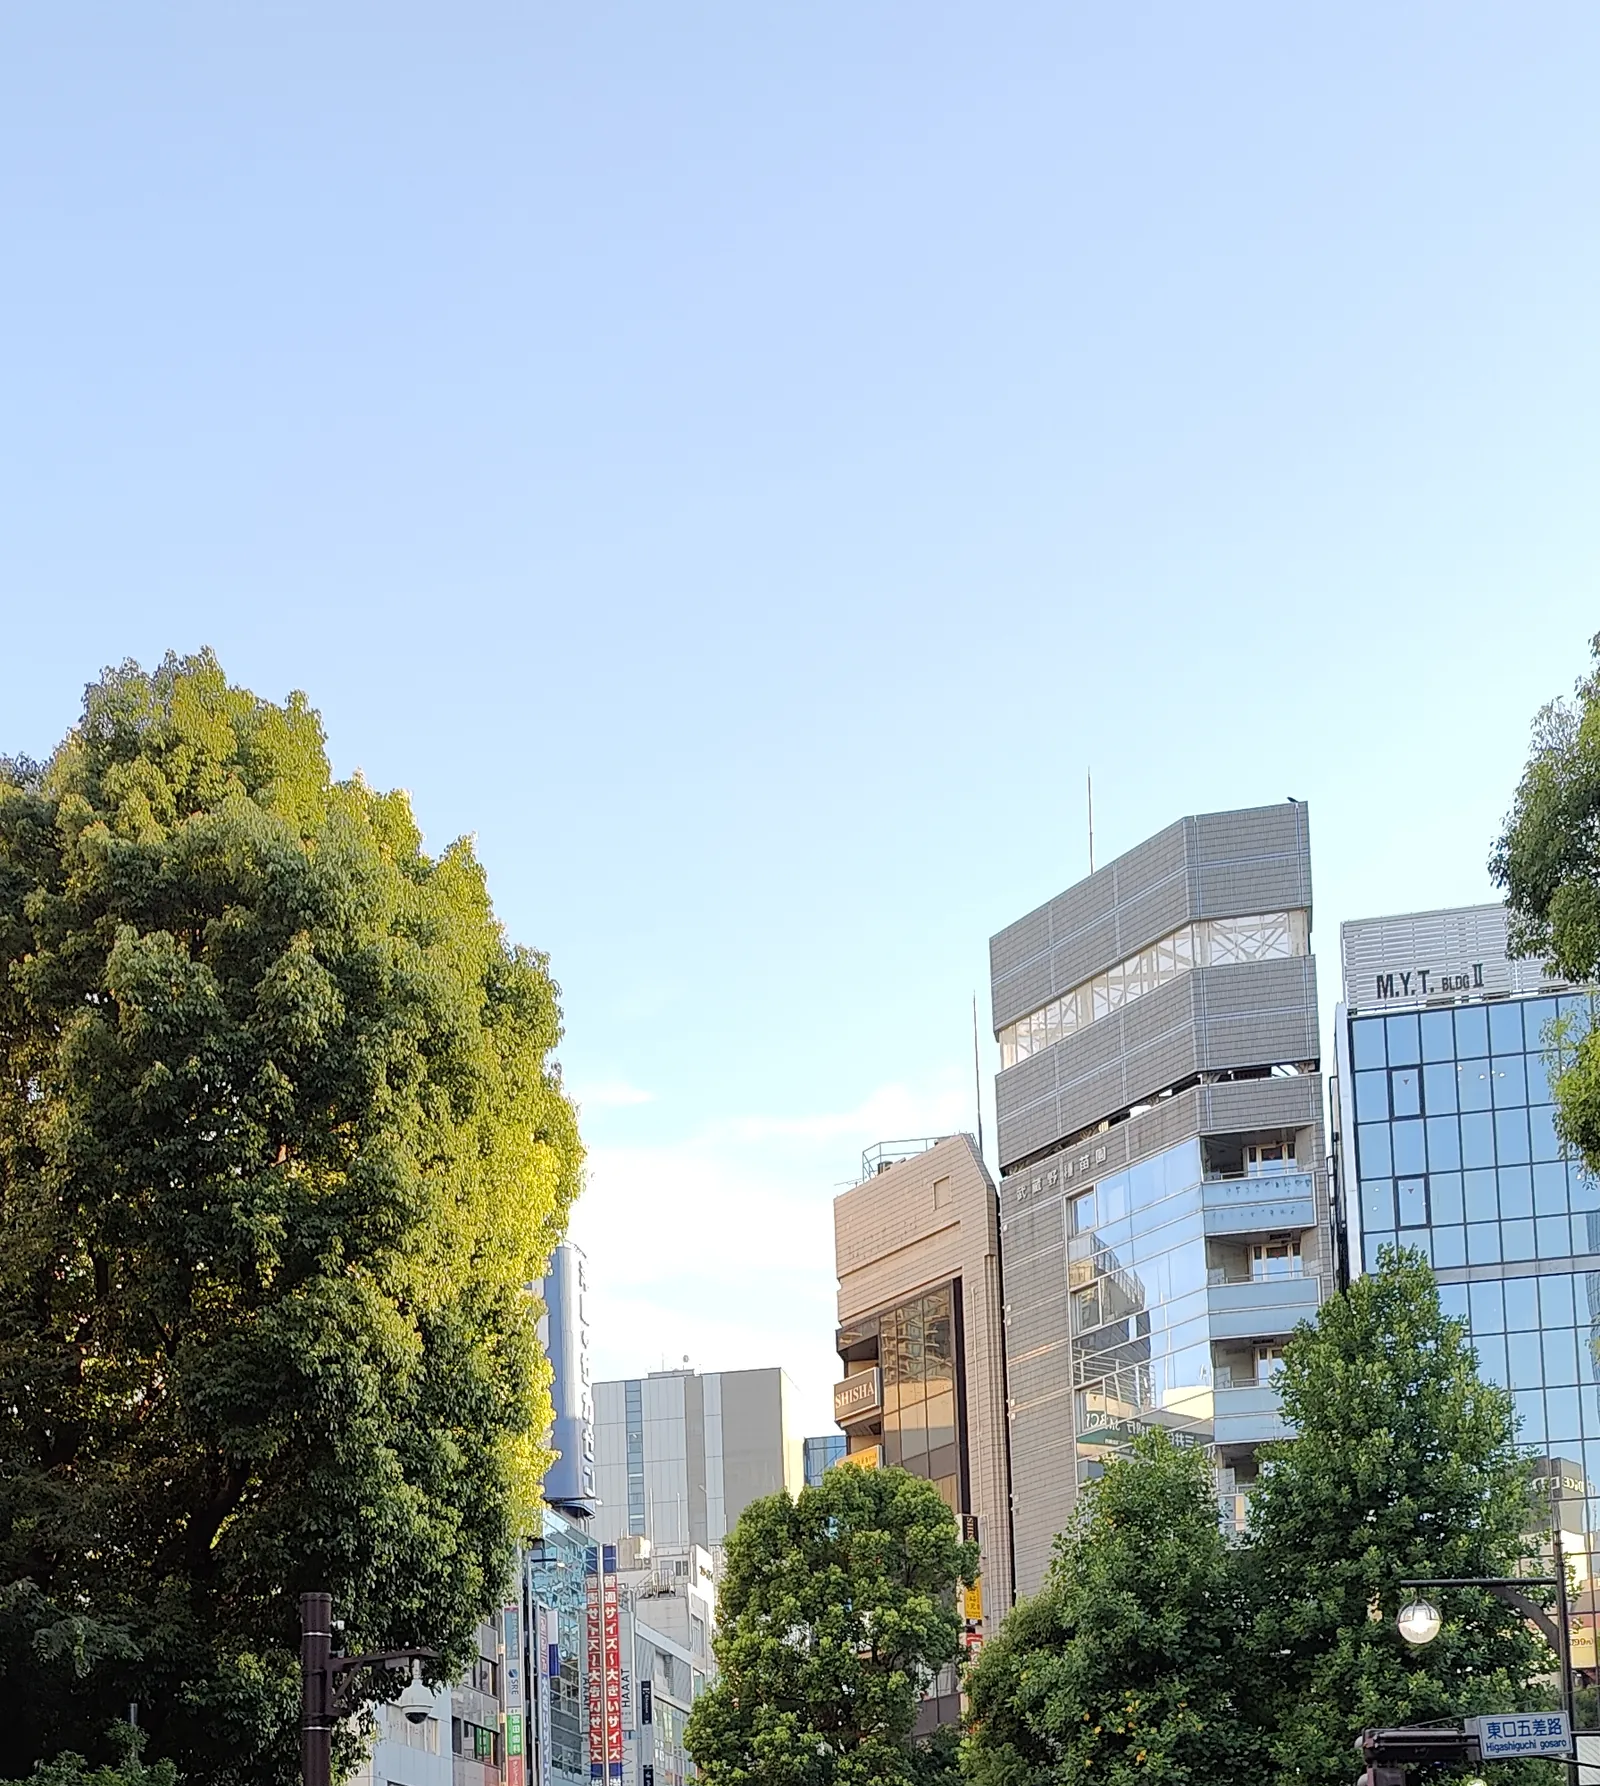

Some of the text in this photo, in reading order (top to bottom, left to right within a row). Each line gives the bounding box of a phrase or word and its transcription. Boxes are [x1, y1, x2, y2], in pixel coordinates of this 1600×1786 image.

[1376, 970, 1435, 999] M.Y.T.
[1441, 975, 1470, 991] BLDG
[835, 1381, 875, 1409] SHISHA
[511, 1679, 519, 1695] SRE
[1486, 1718, 1562, 1740] 東口五差路
[1486, 1739, 1567, 1753] Higashiguchi gosaro
